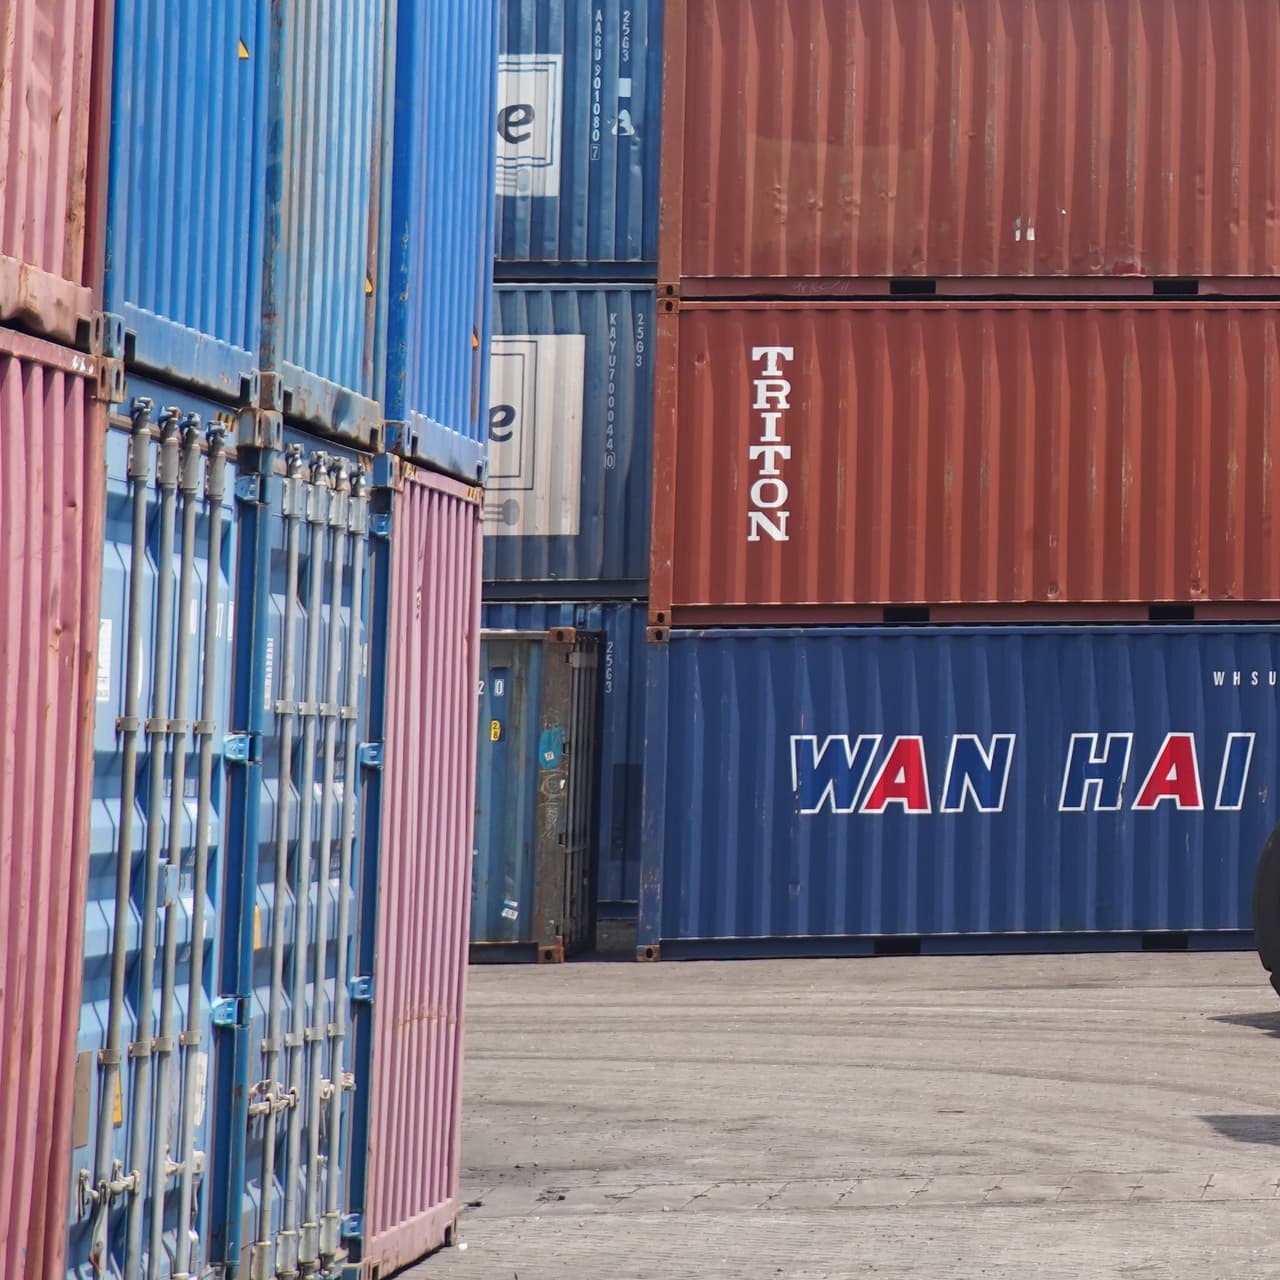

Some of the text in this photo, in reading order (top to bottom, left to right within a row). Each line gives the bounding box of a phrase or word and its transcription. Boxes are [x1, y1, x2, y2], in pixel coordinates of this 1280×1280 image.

[622, 9, 632, 62] 25G3
[635, 312, 645, 368] 25G3
[747, 346, 794, 542] TRITON
[1213, 671, 1277, 686] WHSU
[790, 732, 1256, 814] WAN HAI
